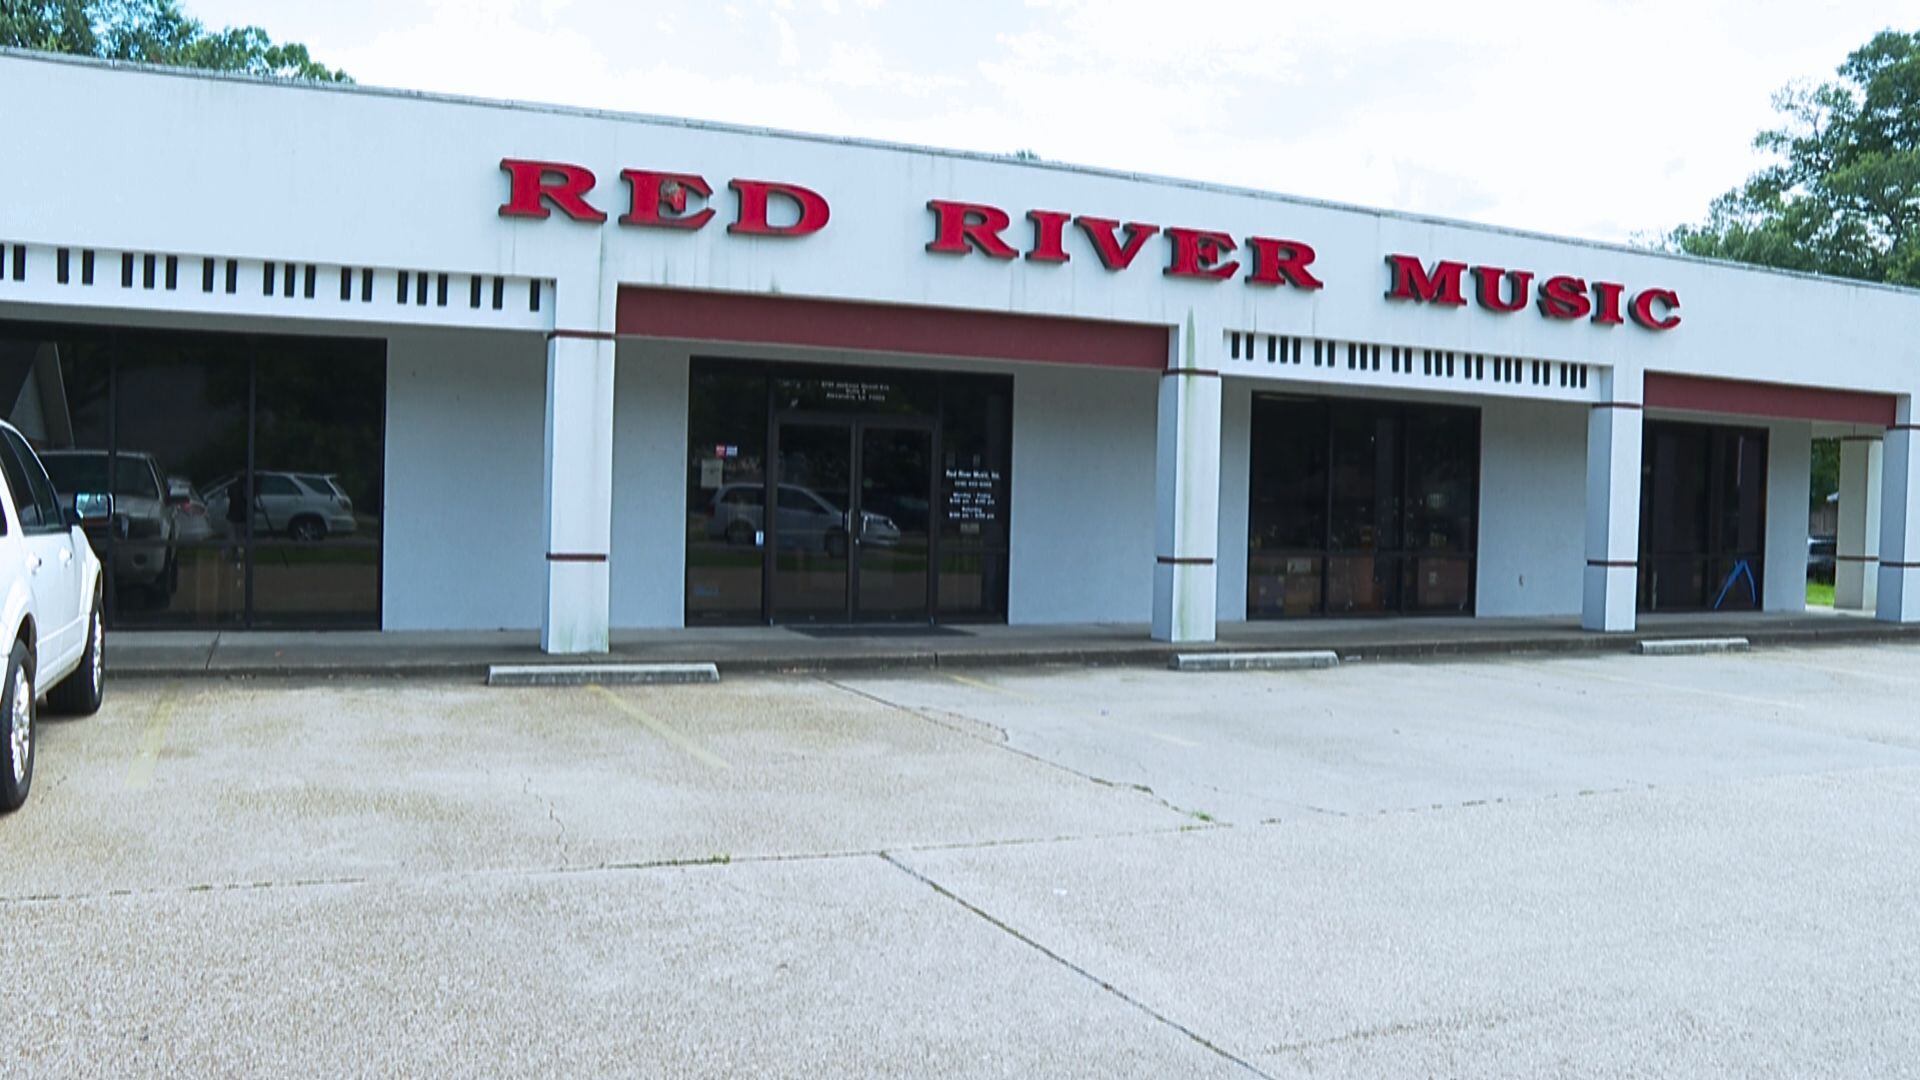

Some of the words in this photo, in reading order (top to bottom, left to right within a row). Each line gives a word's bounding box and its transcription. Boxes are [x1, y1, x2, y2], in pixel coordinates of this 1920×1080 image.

[498, 158, 830, 236] RED
[925, 199, 1324, 291] RIVER
[1384, 253, 1682, 331] MUSIC
